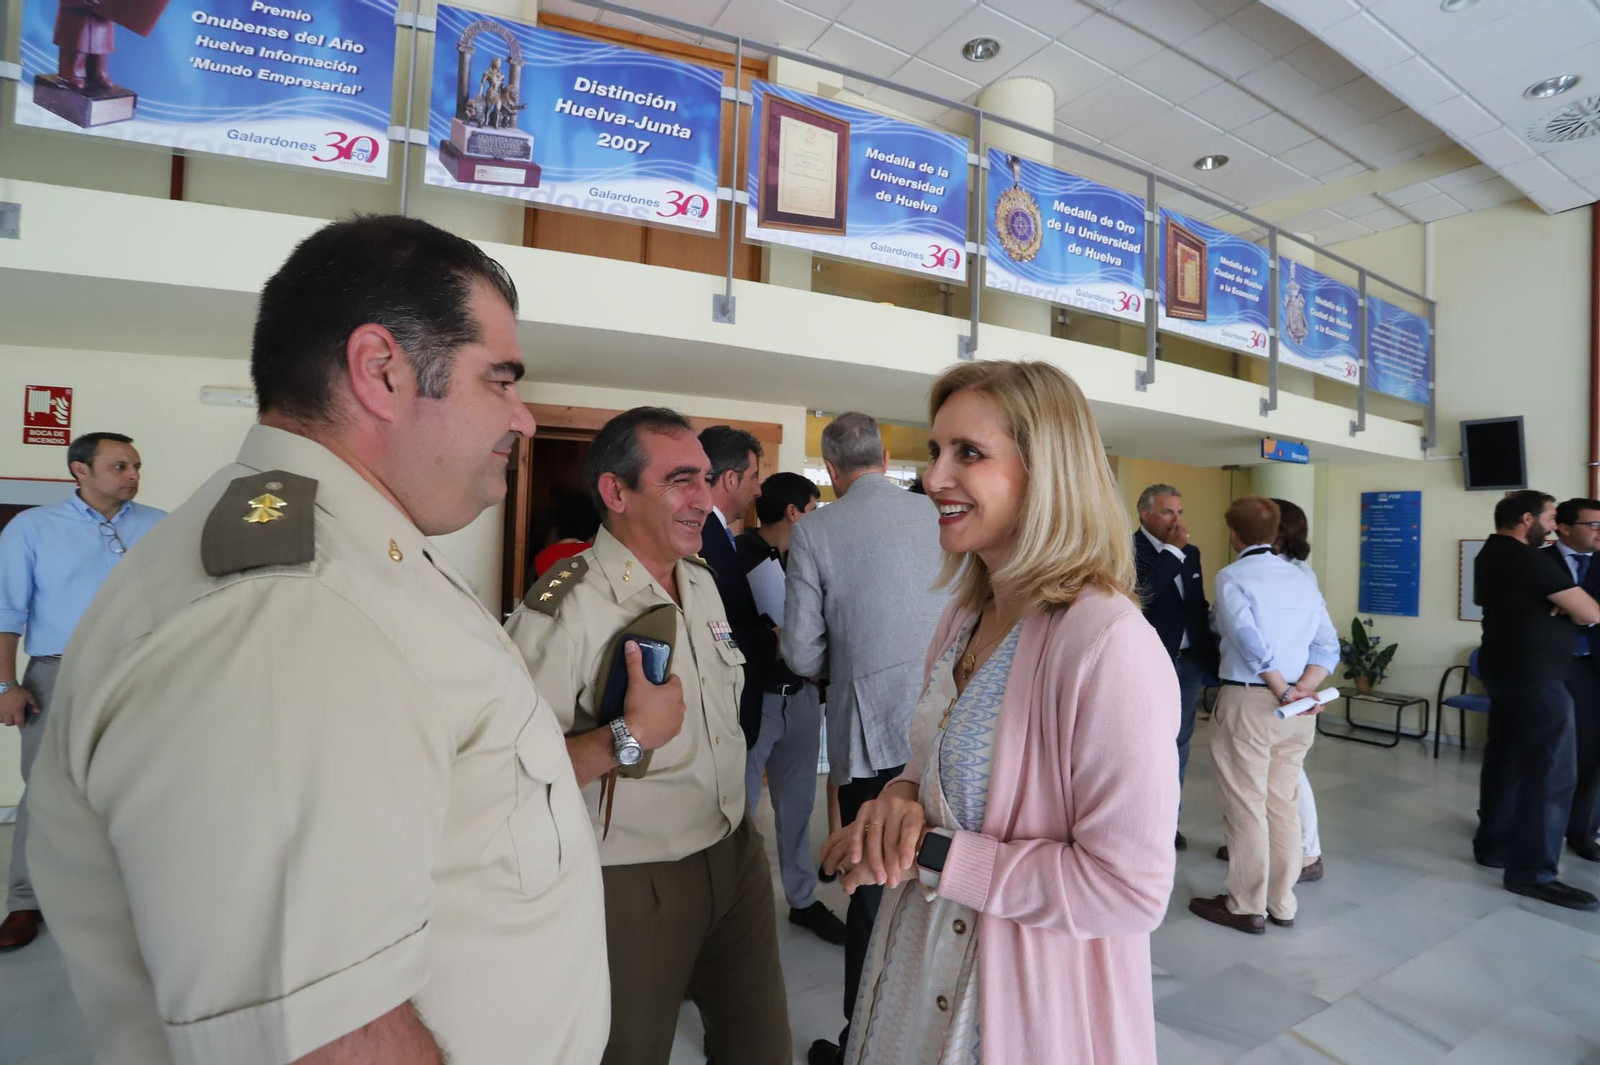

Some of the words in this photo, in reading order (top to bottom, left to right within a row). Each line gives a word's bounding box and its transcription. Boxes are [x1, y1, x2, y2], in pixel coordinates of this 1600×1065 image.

[251, 0, 312, 23] Premio
[191, 10, 289, 41] Onubense
[294, 29, 324, 47] del
[328, 32, 365, 55] Año
[195, 34, 256, 57] Huelva
[259, 45, 359, 75] Información
[573, 76, 678, 112] Distinción
[554, 98, 692, 140] Huelva-Junta
[227, 129, 317, 152] Galardones
[312, 131, 380, 163] 30
[595, 132, 651, 155] 2007
[866, 147, 916, 169] Medalla
[918, 162, 935, 174] de
[937, 166, 949, 179] la
[870, 168, 945, 196] Universidad
[588, 187, 660, 208] Galardones
[656, 190, 709, 218] 30
[875, 190, 892, 202] de
[895, 194, 938, 214] Huelva
[1053, 200, 1097, 223] Medalla
[1100, 215, 1114, 228] de
[1116, 220, 1135, 235] Oro
[1047, 218, 1061, 230] de
[1064, 222, 1075, 235] la
[1078, 226, 1141, 254] Universidad
[870, 242, 924, 260] Galardones
[921, 244, 960, 269] 30
[1068, 243, 1082, 255] de
[1085, 246, 1122, 267] Huelva
[1220, 256, 1243, 271] Medalla
[1244, 265, 1251, 273] de
[1252, 268, 1257, 276] la
[1214, 267, 1235, 280] Ciudad
[1236, 276, 1243, 284] de
[1244, 278, 1263, 290] Huelva
[1225, 284, 1231, 292] la
[1076, 289, 1115, 305] Galardones
[1113, 291, 1141, 313] 30
[1247, 330, 1266, 349] 30
